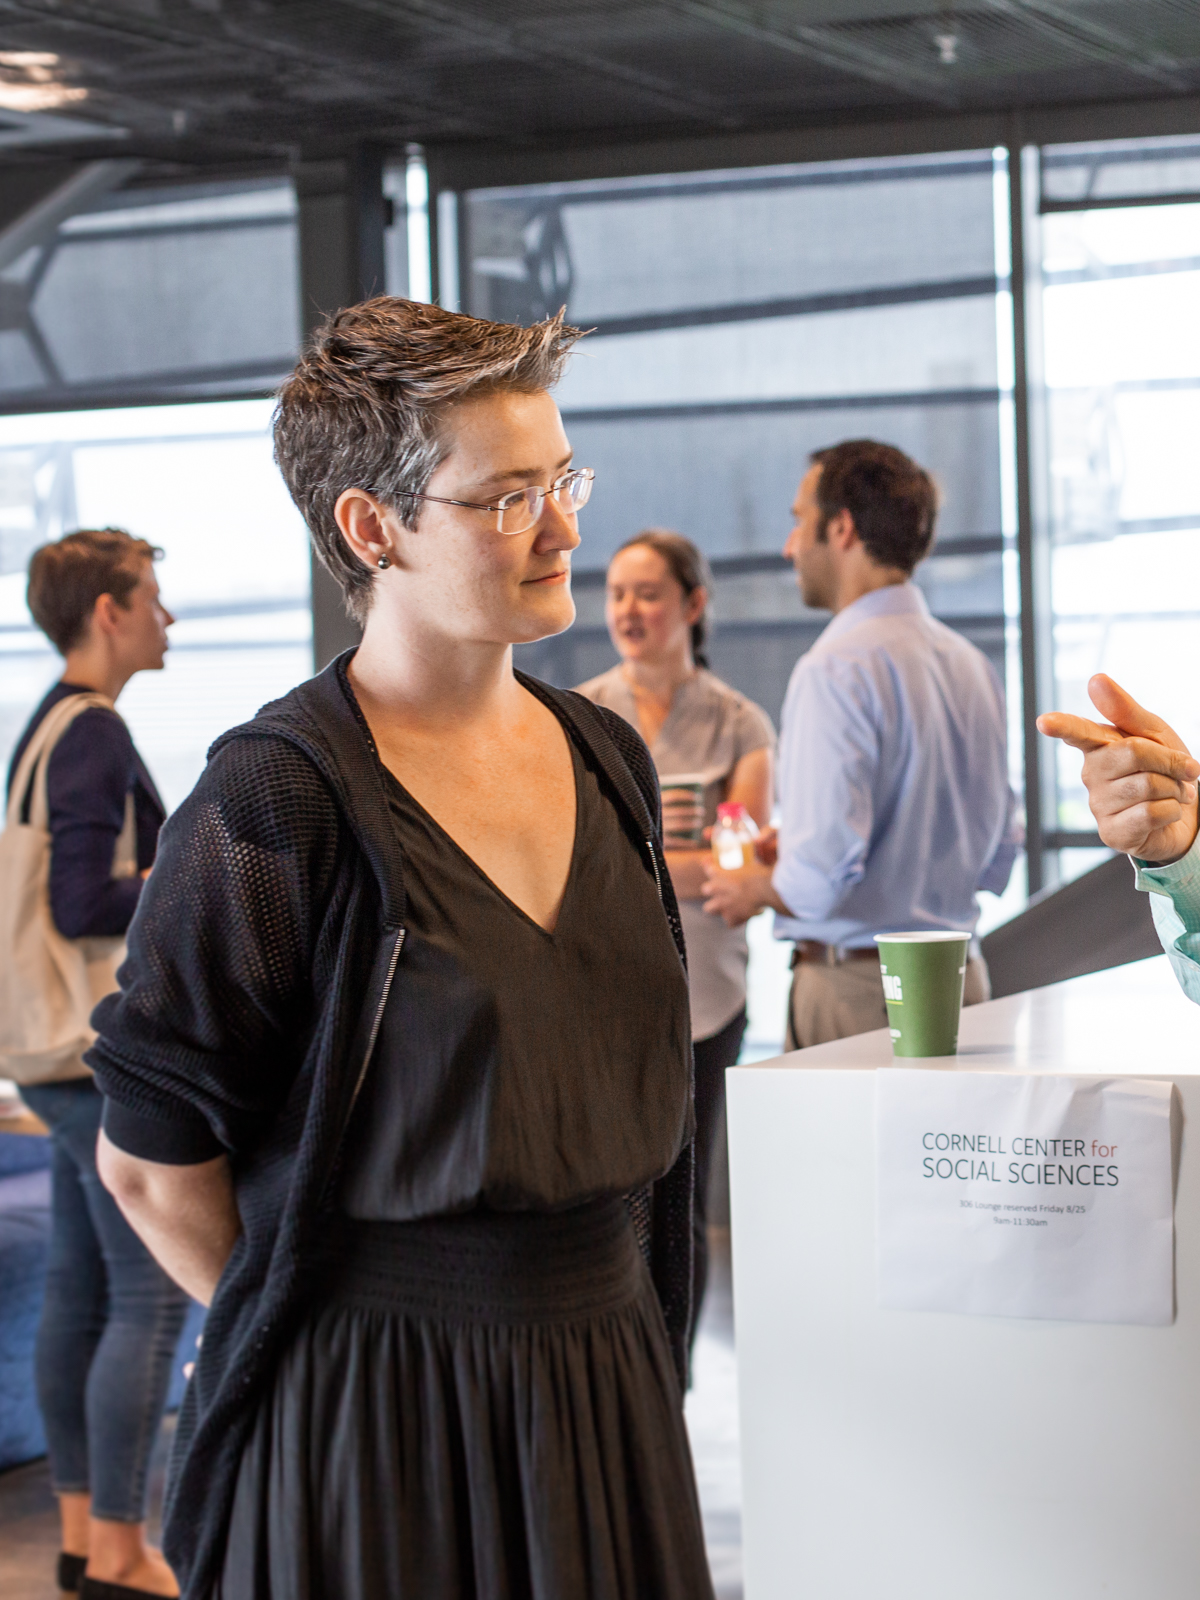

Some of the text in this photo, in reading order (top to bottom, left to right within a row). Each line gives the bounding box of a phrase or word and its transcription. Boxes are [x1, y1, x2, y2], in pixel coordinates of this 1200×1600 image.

[922, 1132, 1118, 1158] CORNELL CENTER for
[922, 1157, 1119, 1187] SOCIAL SCIENCES
[959, 1200, 1086, 1214] 306 Lounge reserved Friday 8/25
[993, 1216, 1048, 1226] 9am-11:30am
